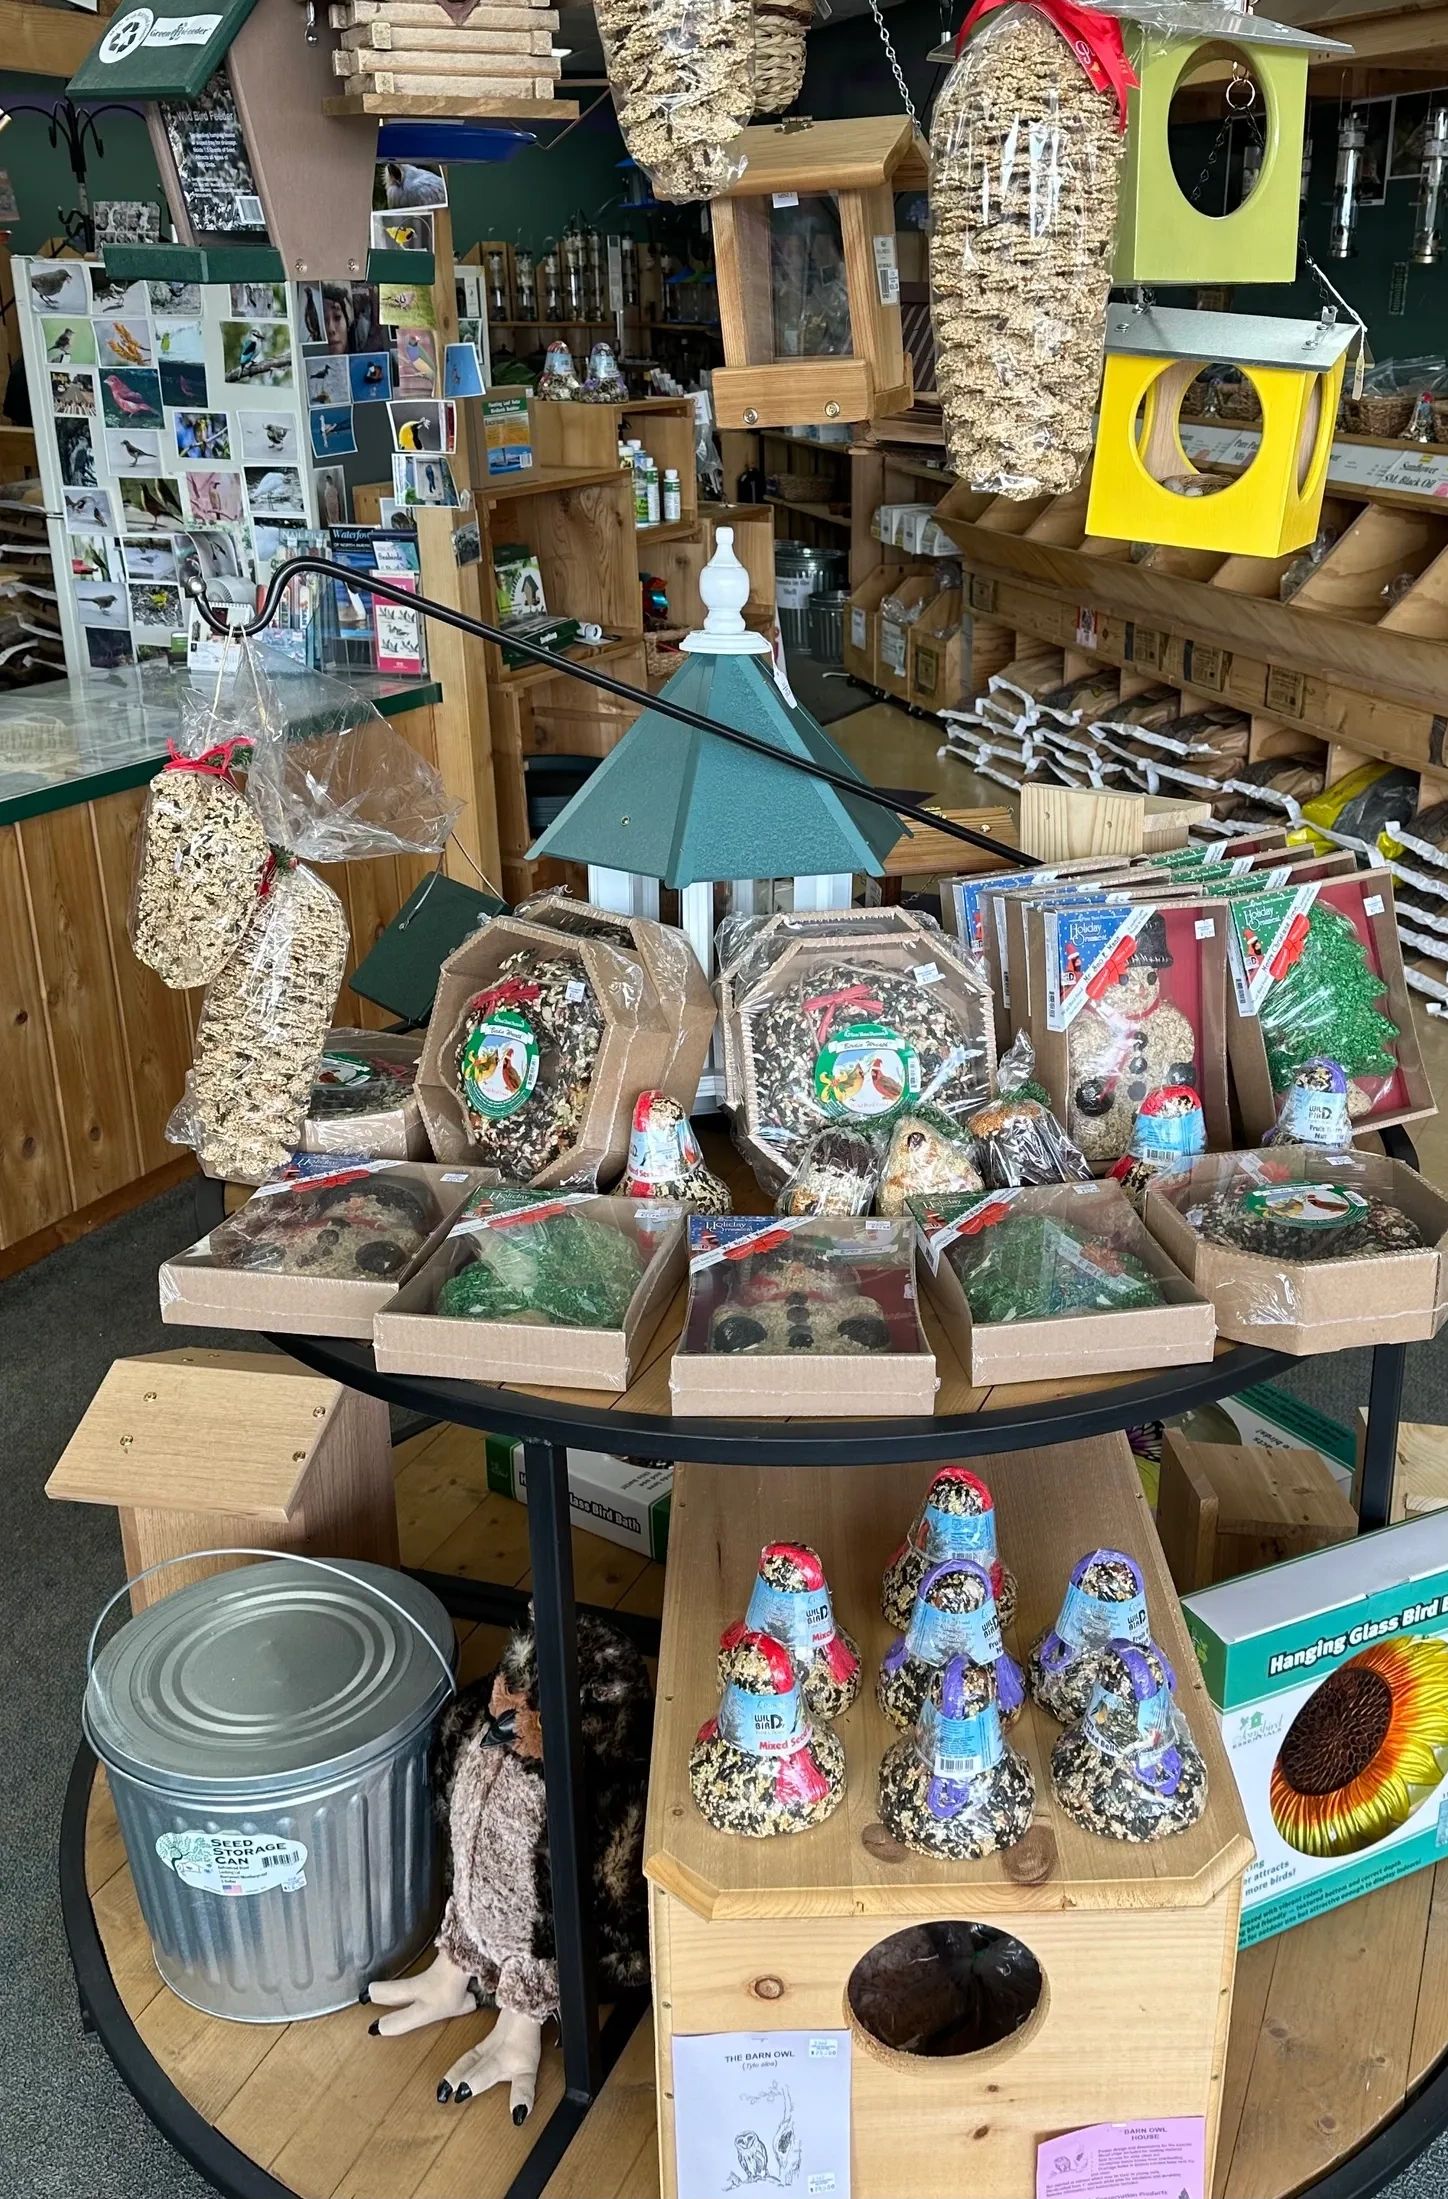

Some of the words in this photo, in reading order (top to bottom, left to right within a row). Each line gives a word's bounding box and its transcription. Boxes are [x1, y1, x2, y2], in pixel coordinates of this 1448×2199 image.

[1402, 461, 1439, 475] Sunflower
[1398, 475, 1421, 487] Black
[1421, 479, 1438, 489] Oil
[1243, 906, 1274, 922] Holiday
[1069, 923, 1102, 940] Holiday
[706, 1221, 746, 1232] Holiday
[570, 1495, 590, 1512] lass
[593, 1502, 613, 1522] Bird
[616, 1513, 640, 1533] Bath
[1269, 1634, 1347, 1676] Hanging
[1349, 1615, 1399, 1647] Glass
[1401, 1599, 1439, 1627] Bird
[759, 1740, 788, 1750] Mixed
[211, 1839, 253, 1848] SEED
[213, 1843, 287, 1856] STORAGE
[215, 1857, 249, 1865] CAN
[1253, 1861, 1290, 1881] attracts
[1245, 1882, 1268, 1896] more
[1270, 1868, 1296, 1885] birds!
[725, 2055, 742, 2063] THE
[745, 2052, 771, 2061] BARN
